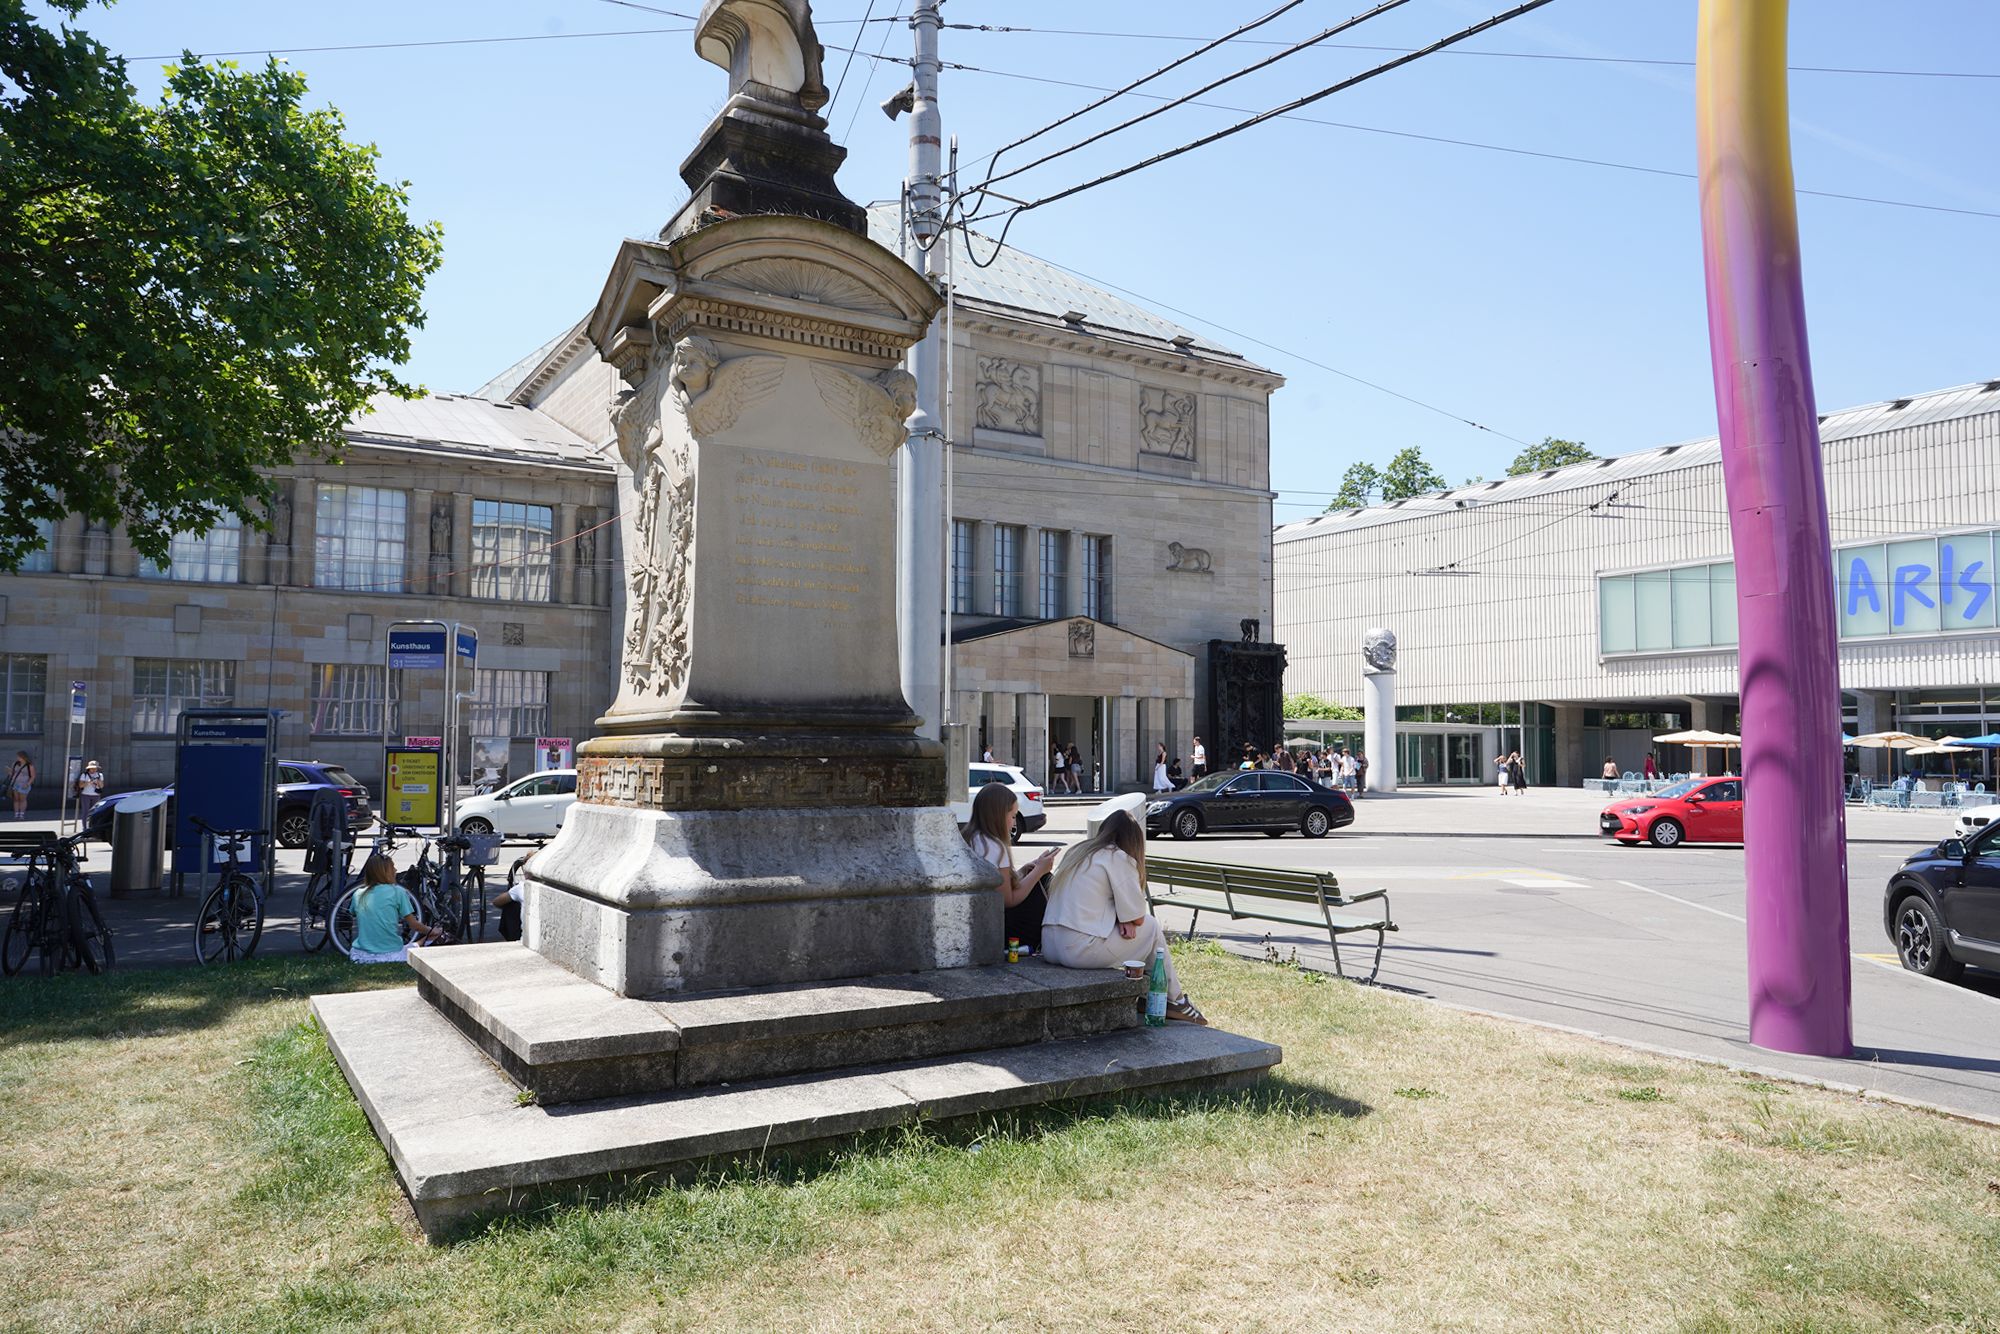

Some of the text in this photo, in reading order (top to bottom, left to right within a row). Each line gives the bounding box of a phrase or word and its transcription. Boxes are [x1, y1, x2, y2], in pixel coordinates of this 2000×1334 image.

[1835, 544, 1992, 626] ARIS
[390, 642, 431, 650] Kunsthaus
[393, 660, 403, 668] 31
[538, 739, 570, 747] Marisol
